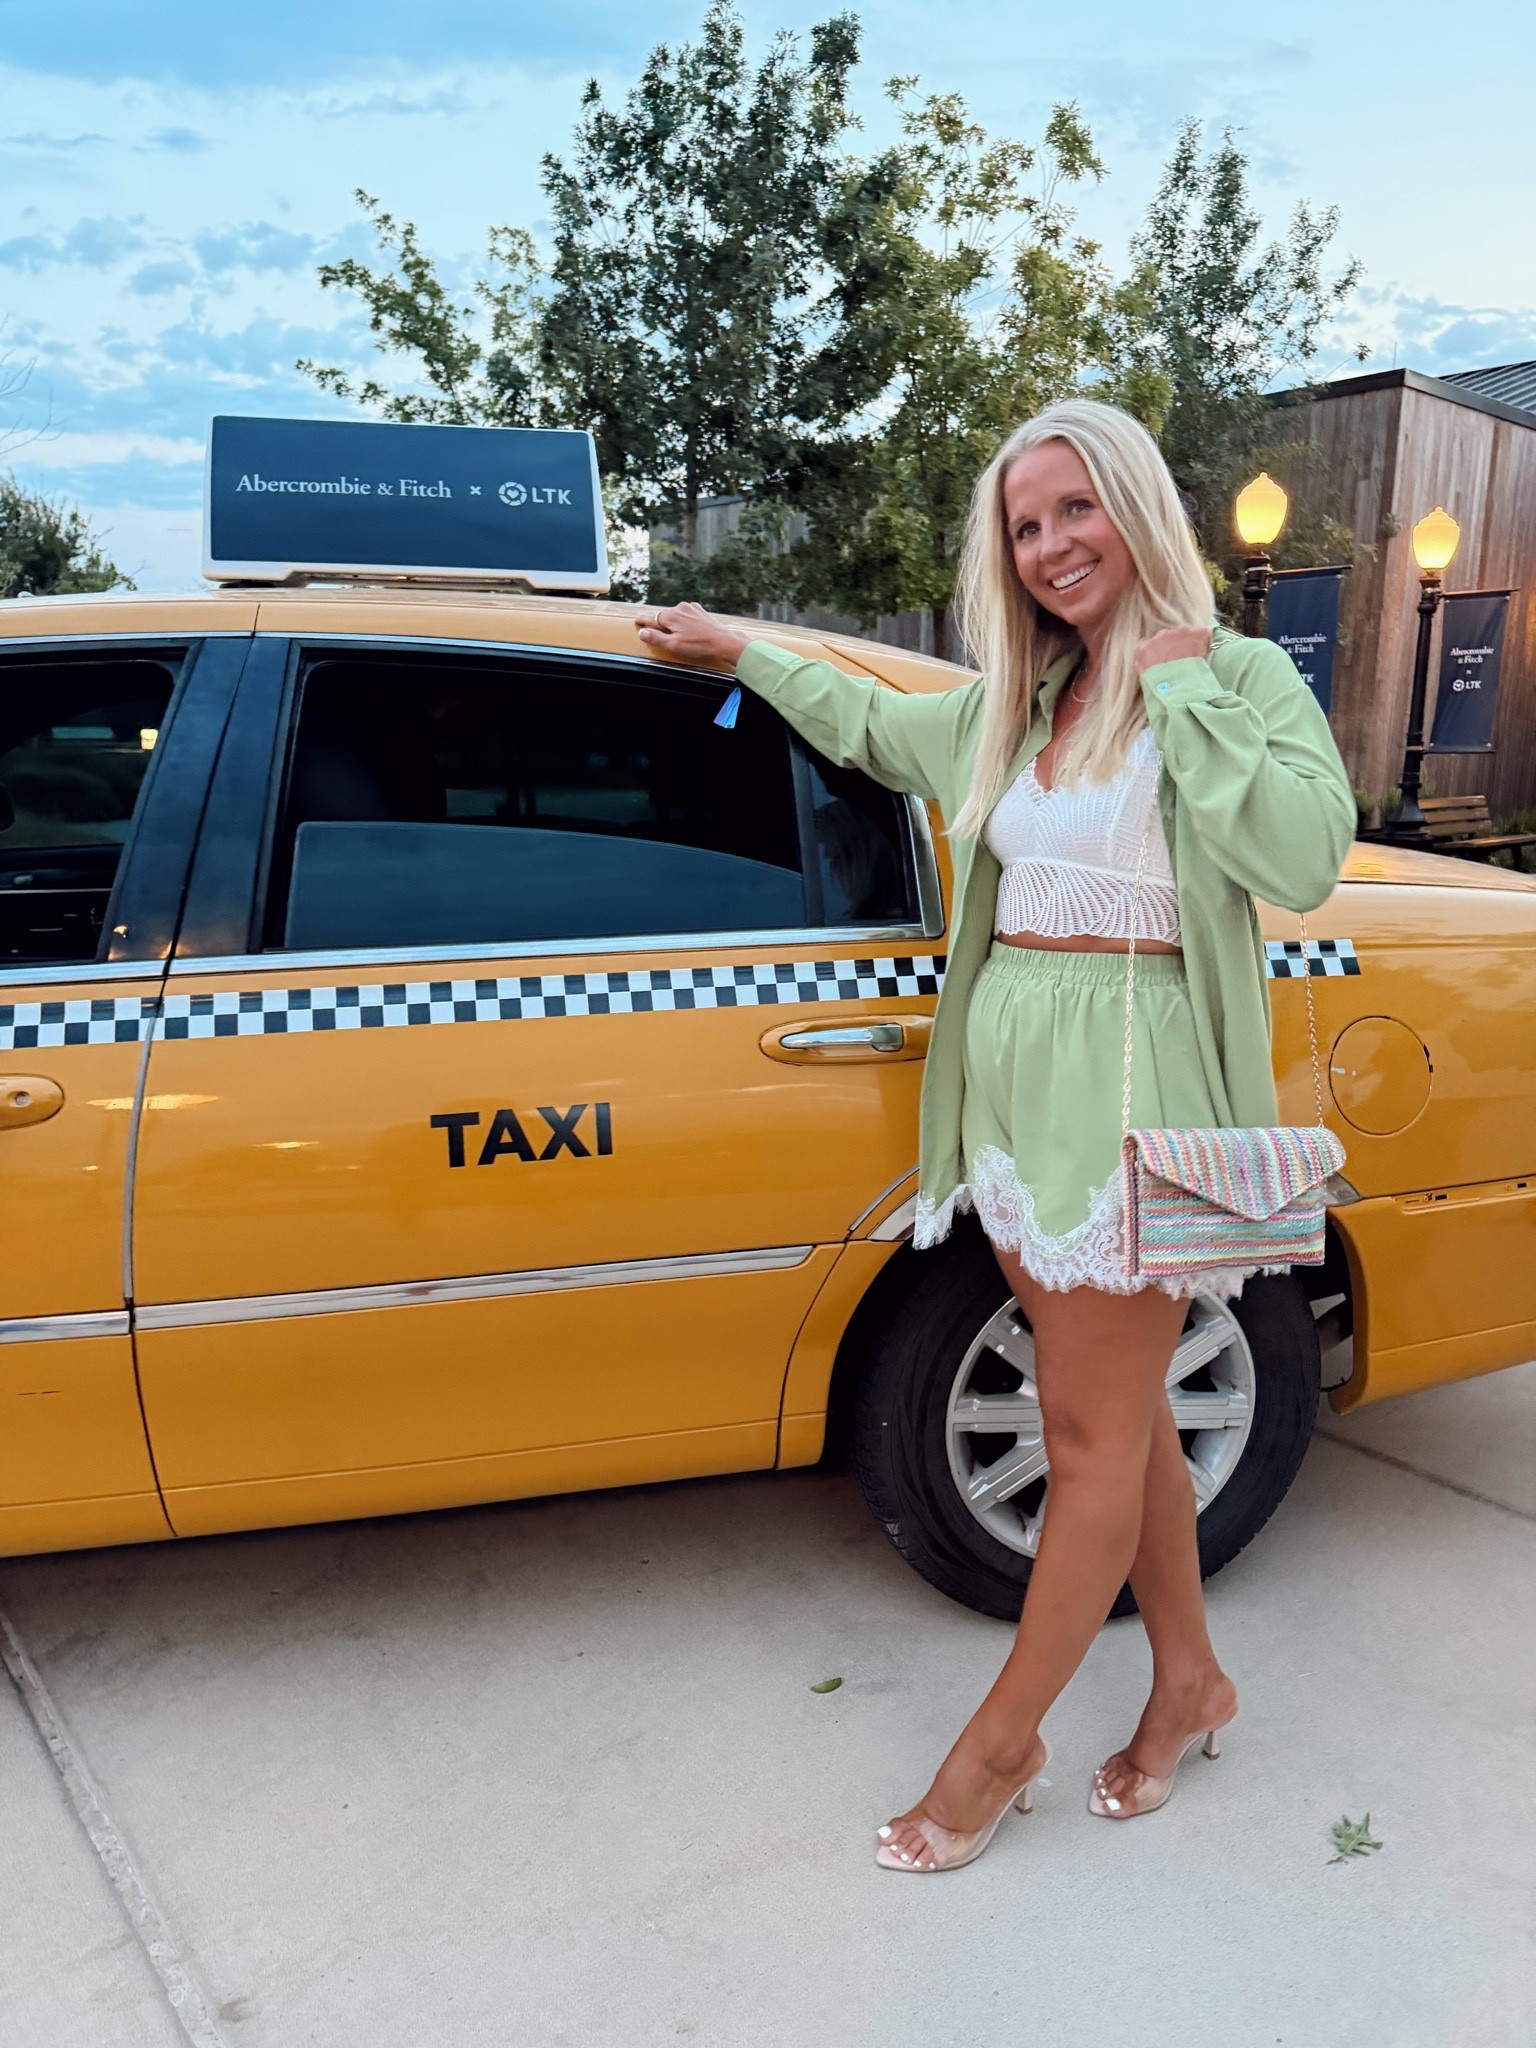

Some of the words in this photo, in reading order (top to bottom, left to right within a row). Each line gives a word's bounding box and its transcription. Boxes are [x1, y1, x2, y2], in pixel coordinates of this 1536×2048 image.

[235, 474, 371, 494] Abercrombie
[376, 482, 394, 496] &
[399, 479, 452, 499] Fitch
[532, 487, 572, 506] LTK
[1278, 633, 1327, 644] Abercrombie
[1300, 673, 1314, 683] TK
[1466, 680, 1482, 689] LTK
[430, 1102, 613, 1168] TAXI
